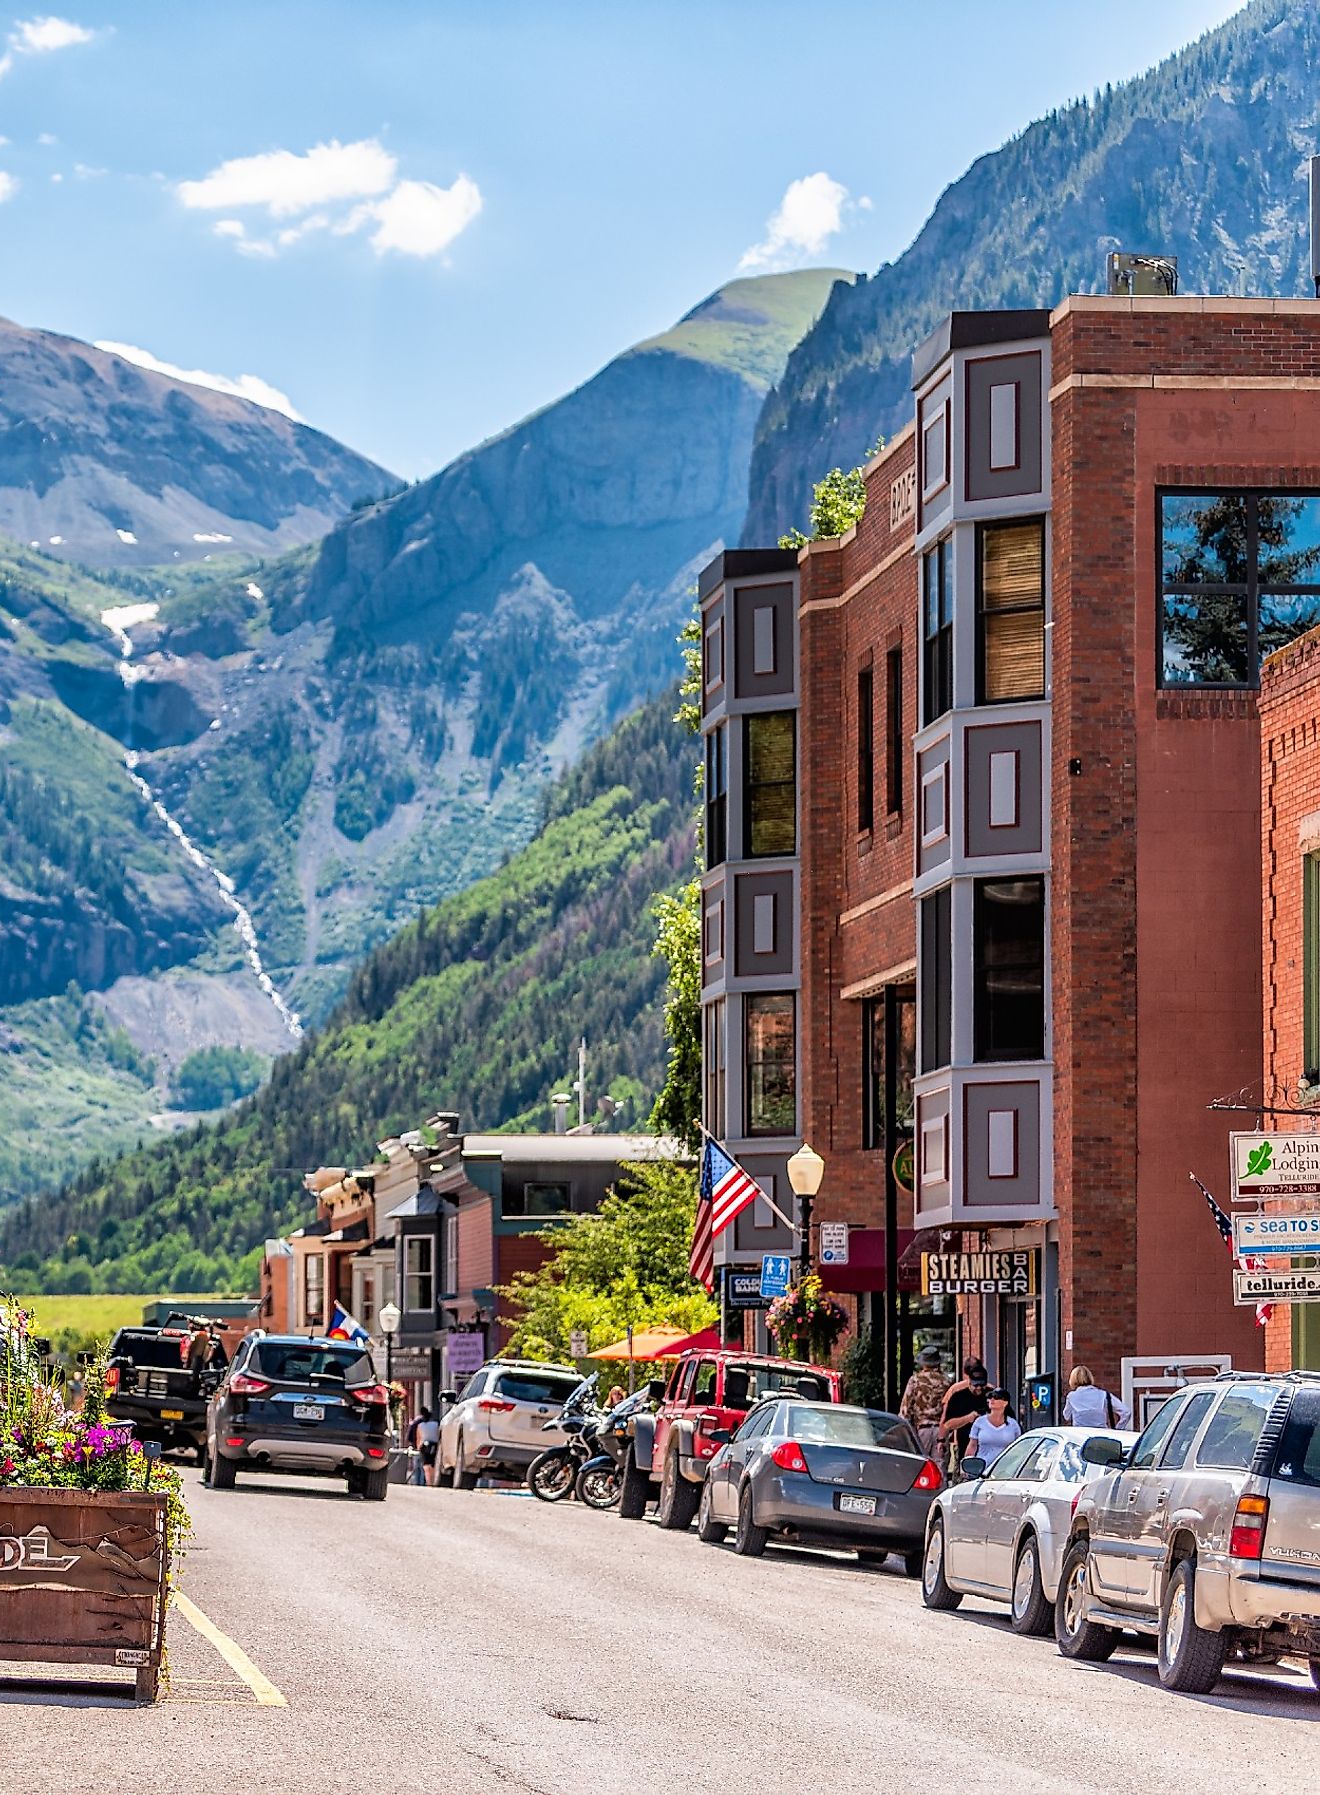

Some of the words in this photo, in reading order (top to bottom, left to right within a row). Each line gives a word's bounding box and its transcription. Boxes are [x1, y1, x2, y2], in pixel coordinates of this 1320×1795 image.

[1282, 1140, 1319, 1157] Alpin
[1272, 1156, 1320, 1173] Lodgin
[1290, 1219, 1308, 1232] TO
[1311, 1219, 1319, 1232] S
[929, 1253, 1011, 1280] STEAMIES
[735, 1278, 761, 1286] COLD
[929, 1280, 1027, 1294] BURGER
[1247, 1276, 1320, 1292] telluride.
